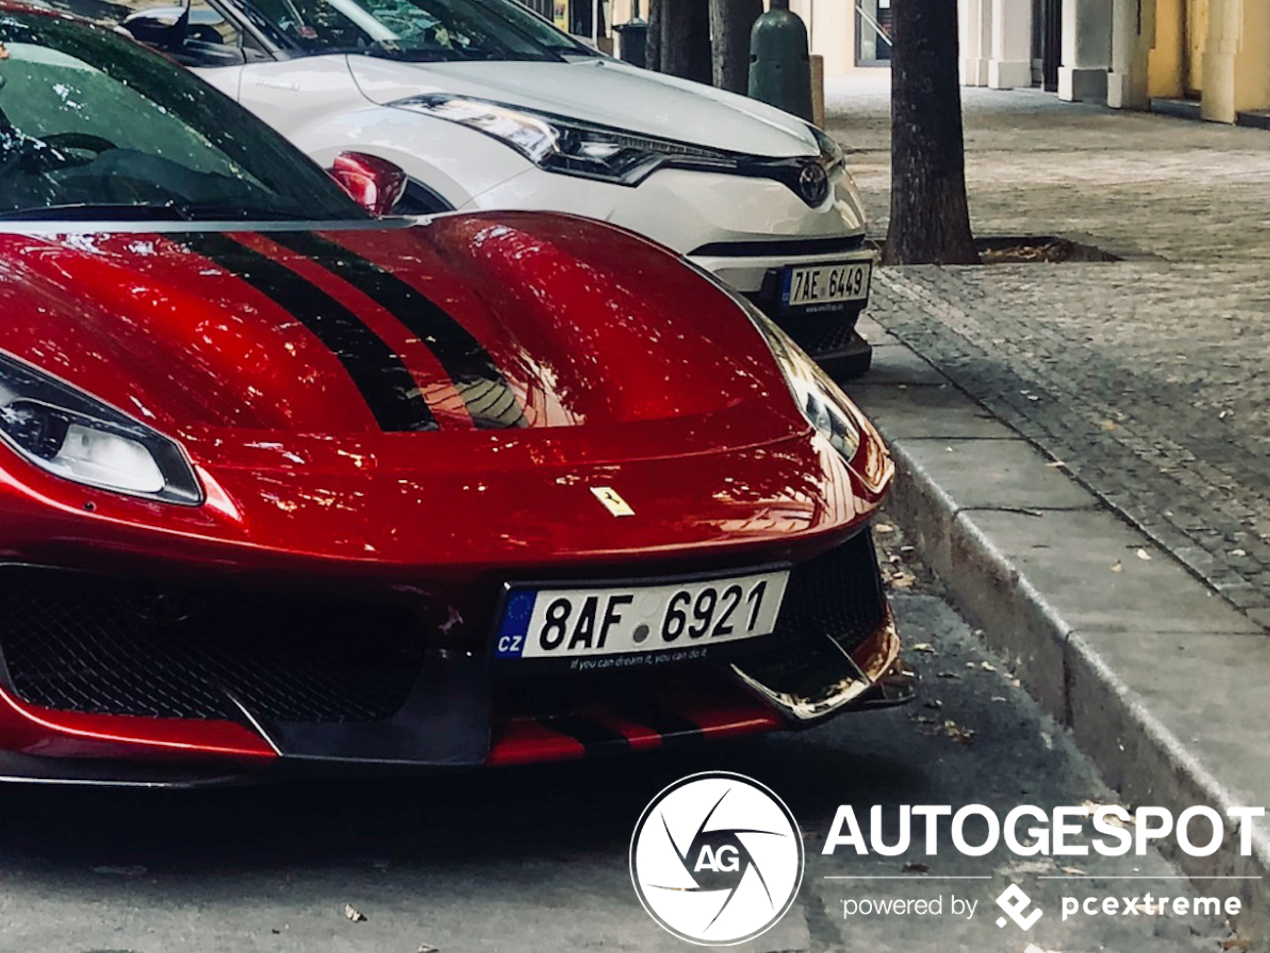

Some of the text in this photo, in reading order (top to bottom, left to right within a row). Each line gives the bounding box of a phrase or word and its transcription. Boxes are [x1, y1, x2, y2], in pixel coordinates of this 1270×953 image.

[793, 267, 863, 302] 7AE 6449
[538, 579, 768, 652] 8AF 6921
[497, 634, 523, 653] CZ
[579, 660, 597, 671] you
[597, 659, 614, 669] can
[615, 655, 644, 667] dream
[654, 654, 671, 666] you
[671, 652, 687, 661] can
[688, 649, 700, 659] do
